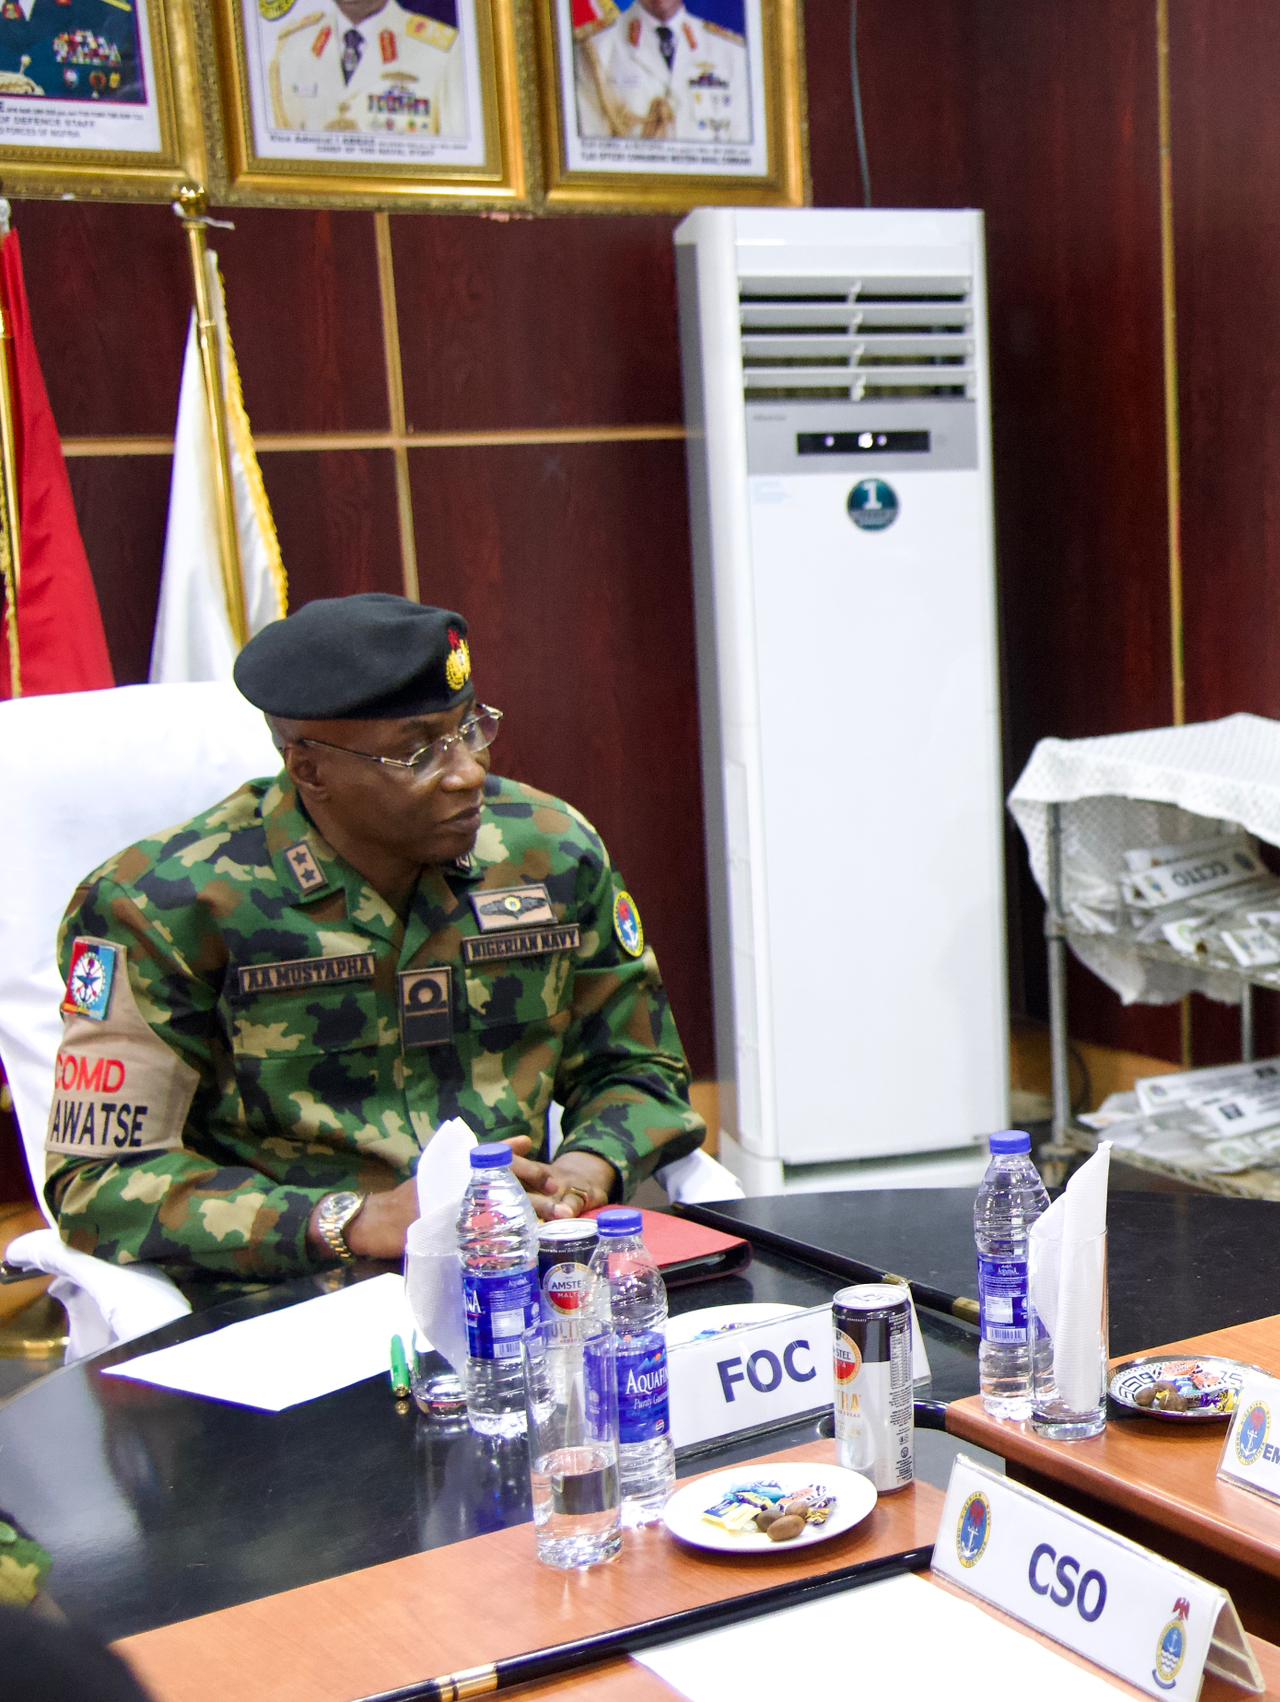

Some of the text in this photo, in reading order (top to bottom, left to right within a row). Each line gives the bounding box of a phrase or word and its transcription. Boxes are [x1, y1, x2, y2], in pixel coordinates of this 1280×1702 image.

[471, 930, 577, 958] NIGERIAN NAVY
[275, 957, 371, 987] MUSTAPHA
[50, 1100, 148, 1147] AWATSE
[551, 1280, 583, 1290] AMSTE
[717, 1340, 817, 1403] FOC
[1028, 1543, 1107, 1622] CSO
